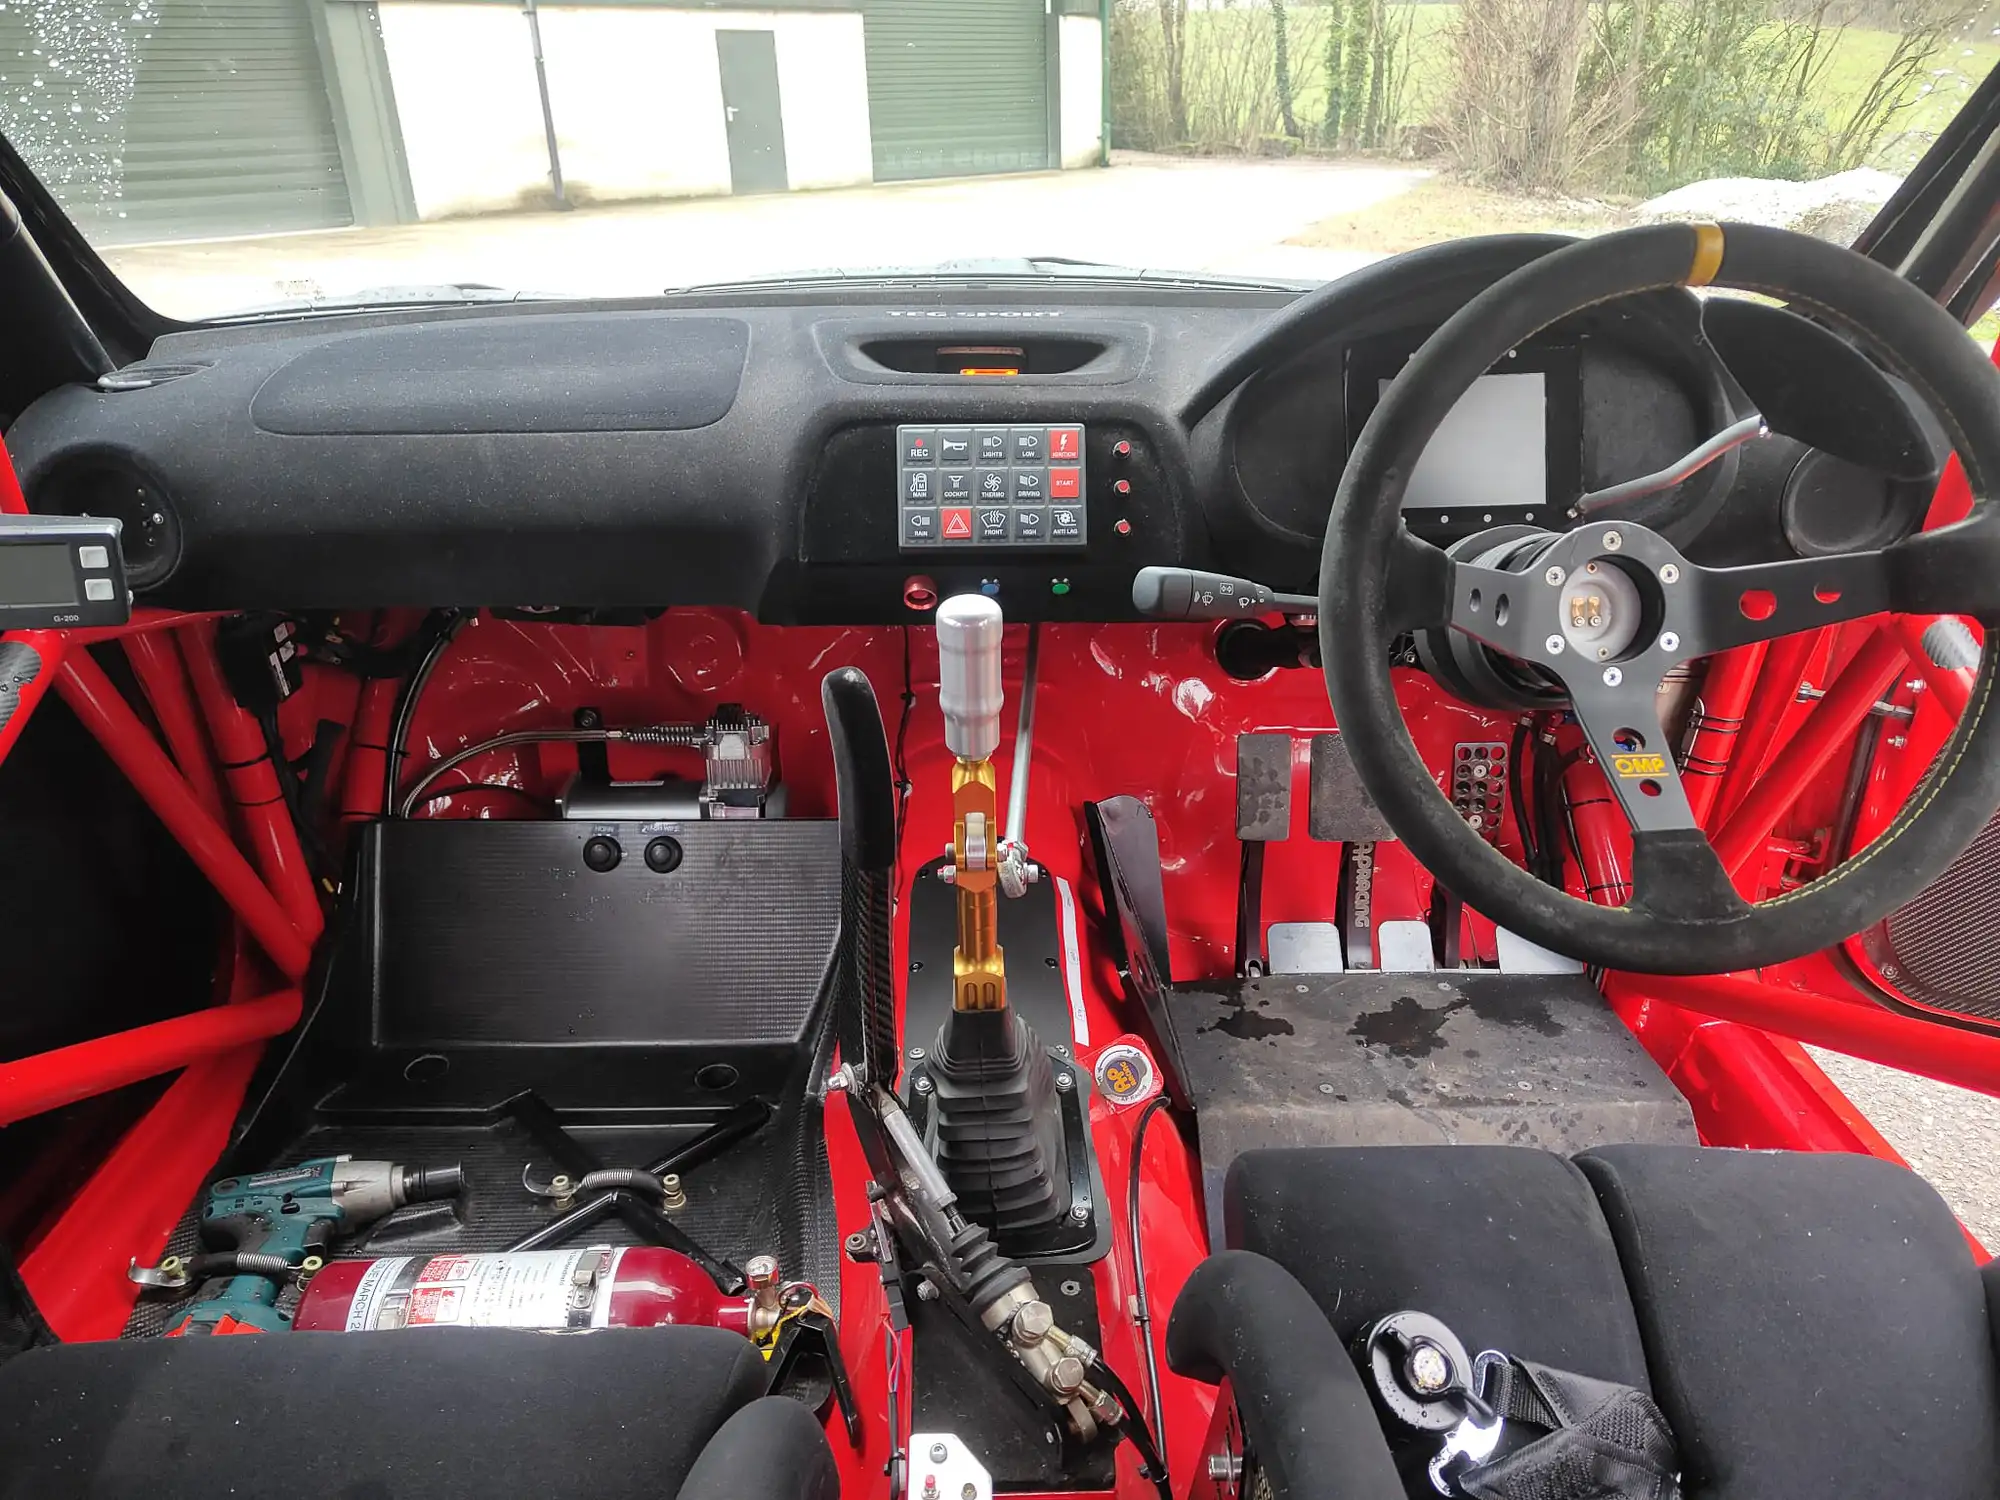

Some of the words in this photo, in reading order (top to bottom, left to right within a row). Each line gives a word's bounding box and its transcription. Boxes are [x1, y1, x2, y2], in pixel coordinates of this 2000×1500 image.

[910, 448, 929, 457] REC
[982, 450, 1003, 458] LIGHTS
[1021, 450, 1035, 458] LOW
[1055, 479, 1074, 487] START
[943, 490, 969, 498] COCKPIT
[1017, 490, 1041, 498] DRIVING
[984, 528, 1004, 536] FRONT
[1053, 528, 1066, 536] ANTI
[1066, 528, 1078, 536] LAG
[53, 614, 80, 623] G-200
[1614, 757, 1666, 774] OMP
[353, 1279, 375, 1319] MARCH
